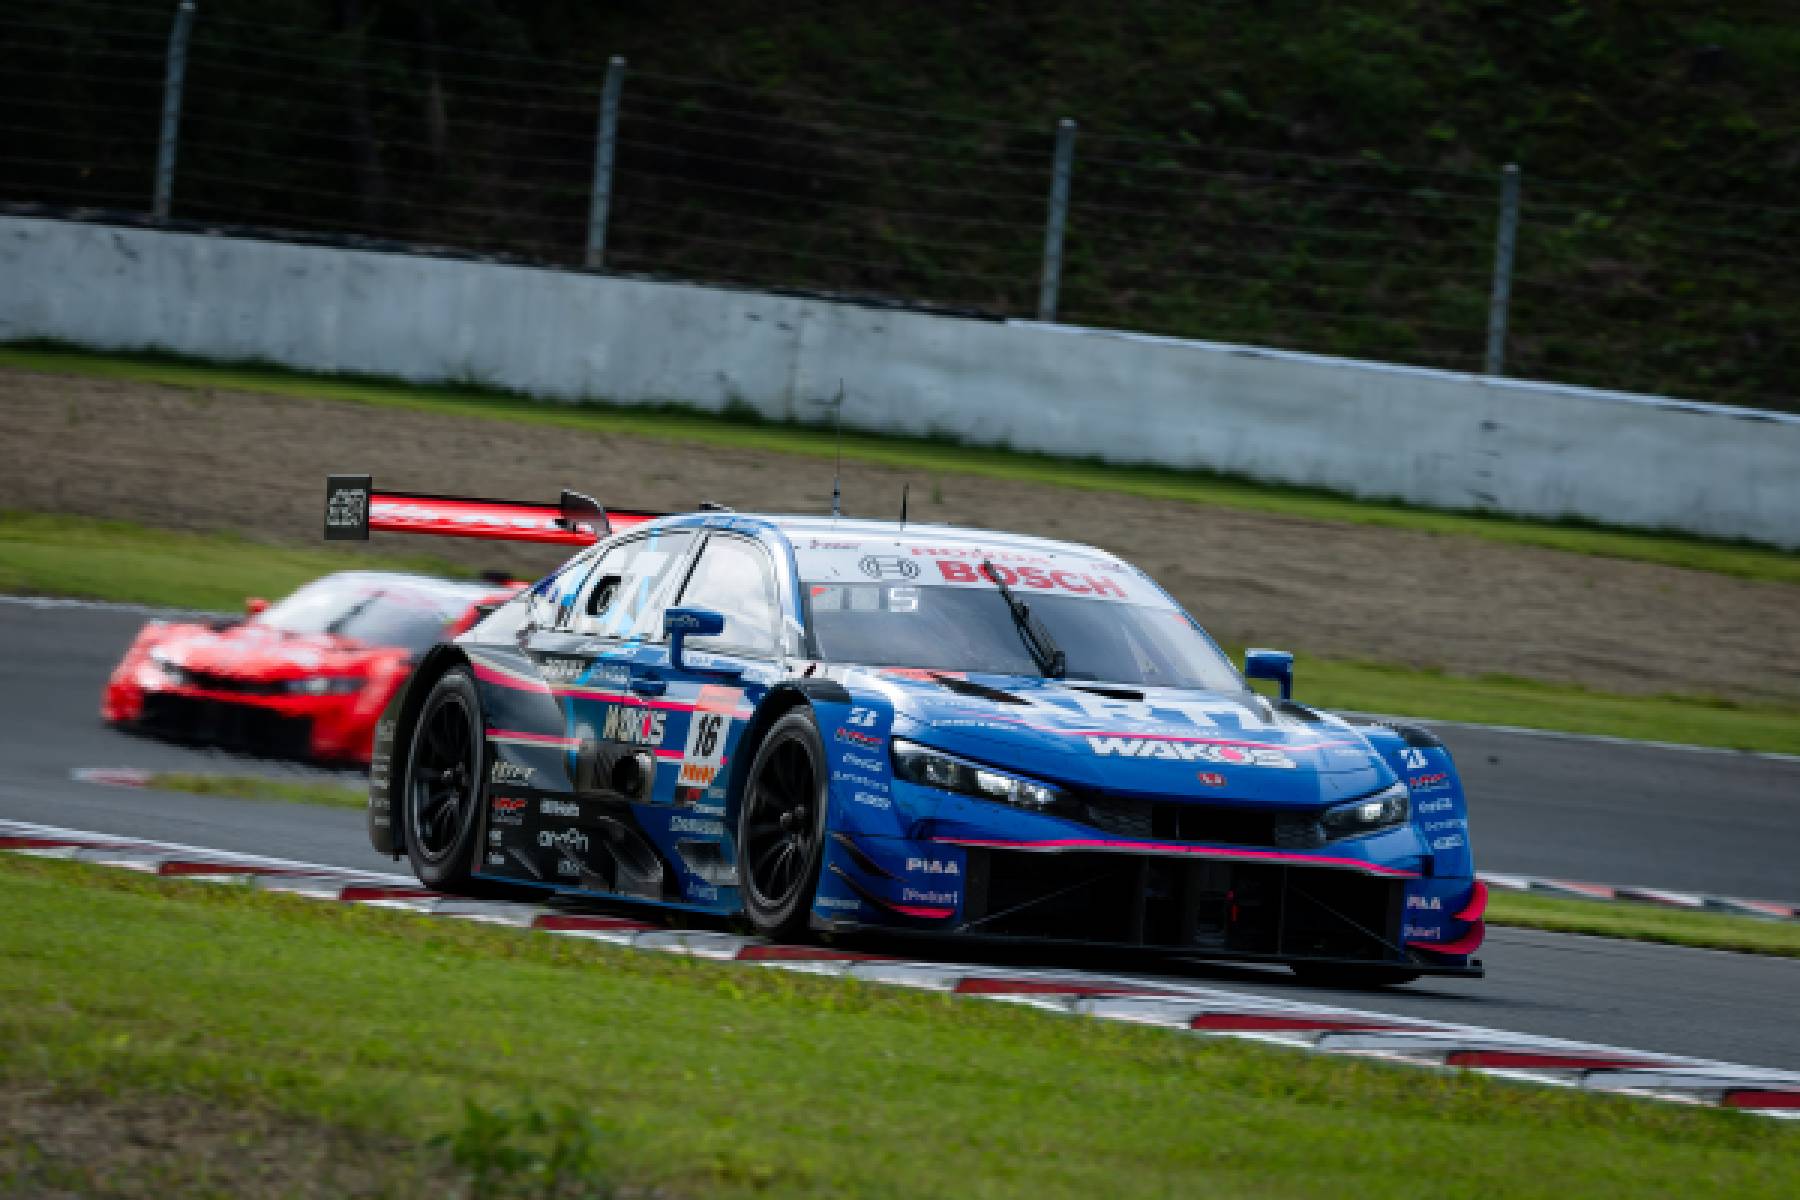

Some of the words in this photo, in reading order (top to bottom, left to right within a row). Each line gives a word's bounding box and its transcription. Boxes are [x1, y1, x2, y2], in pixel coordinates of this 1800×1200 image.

[936, 559, 1128, 596] BOSCH
[693, 714, 722, 757] 16
[905, 857, 960, 875] PIAA
